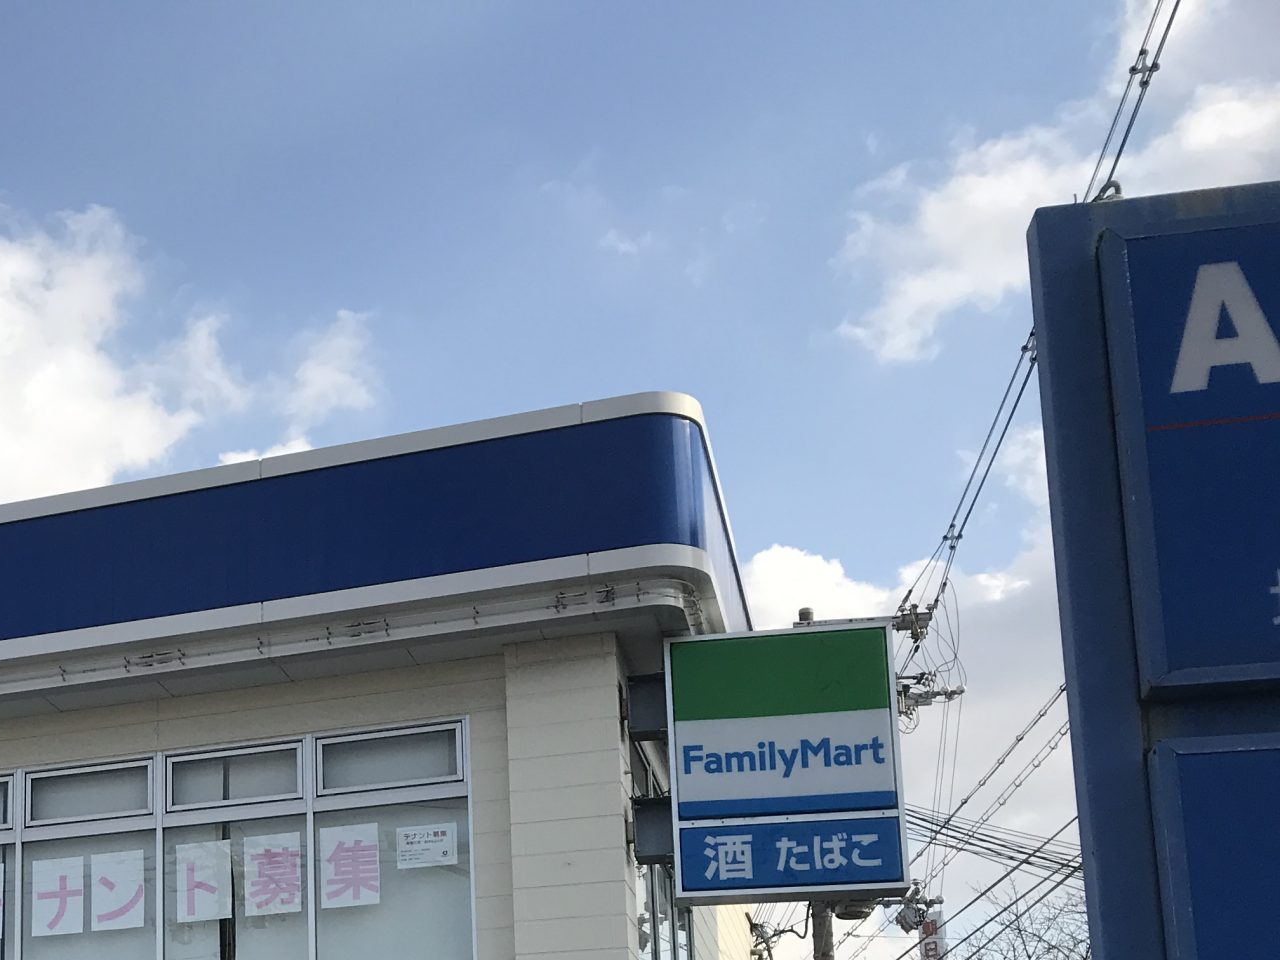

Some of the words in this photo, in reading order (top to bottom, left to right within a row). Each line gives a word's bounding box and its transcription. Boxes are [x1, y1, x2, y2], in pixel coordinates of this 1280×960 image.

[1169, 261, 1280, 394] A
[682, 736, 886, 778] FamilyMart
[703, 834, 754, 881] 酒
[775, 832, 883, 872] たばこ
